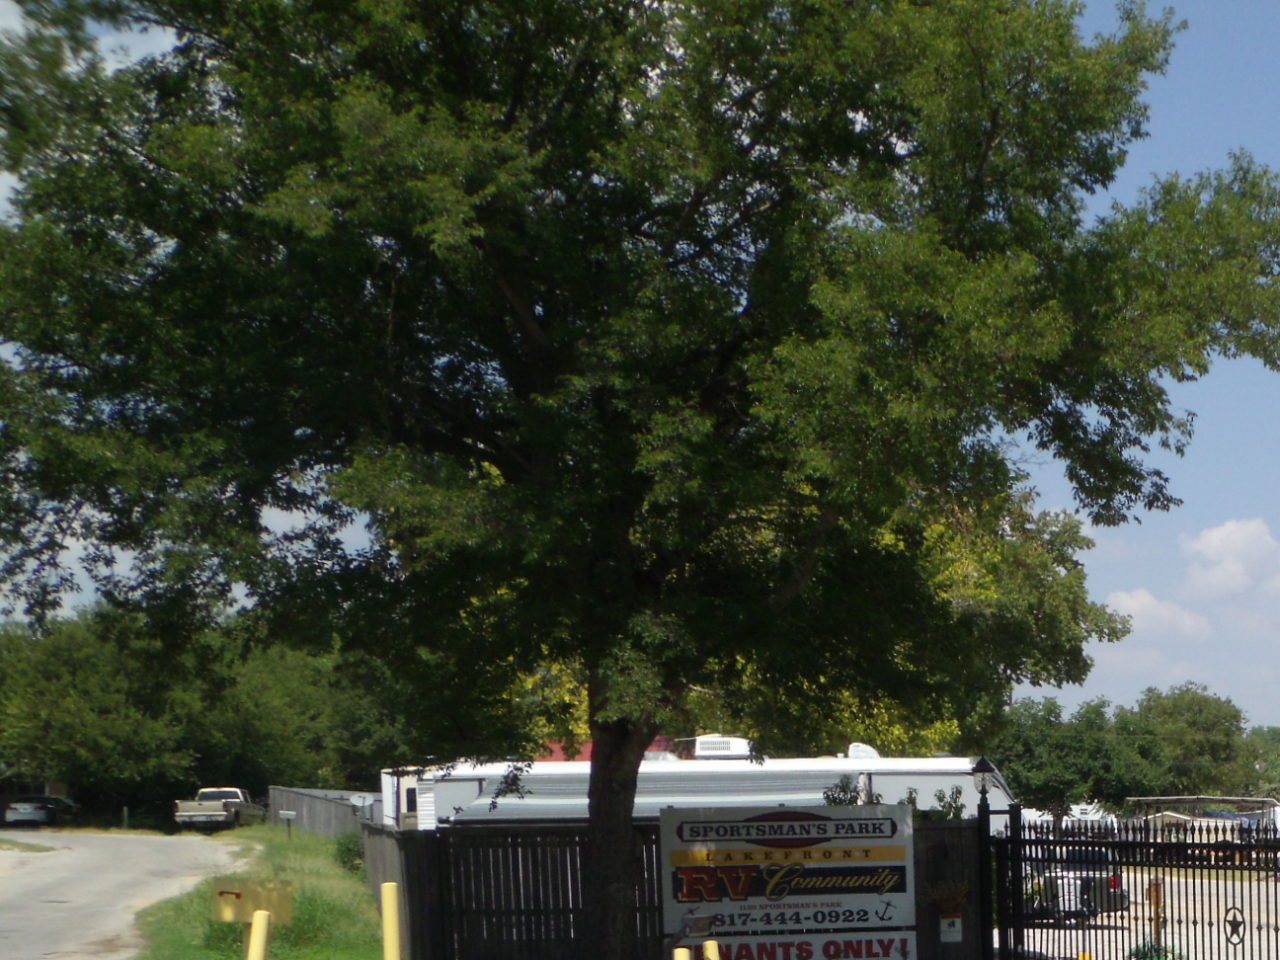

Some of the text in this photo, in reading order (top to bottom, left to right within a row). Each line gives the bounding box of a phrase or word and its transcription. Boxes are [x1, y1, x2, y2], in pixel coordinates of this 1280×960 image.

[689, 821, 885, 838] SPORTSMAN'S PARK
[676, 862, 901, 902] RV Community
[712, 909, 869, 927] 817-444-0922
